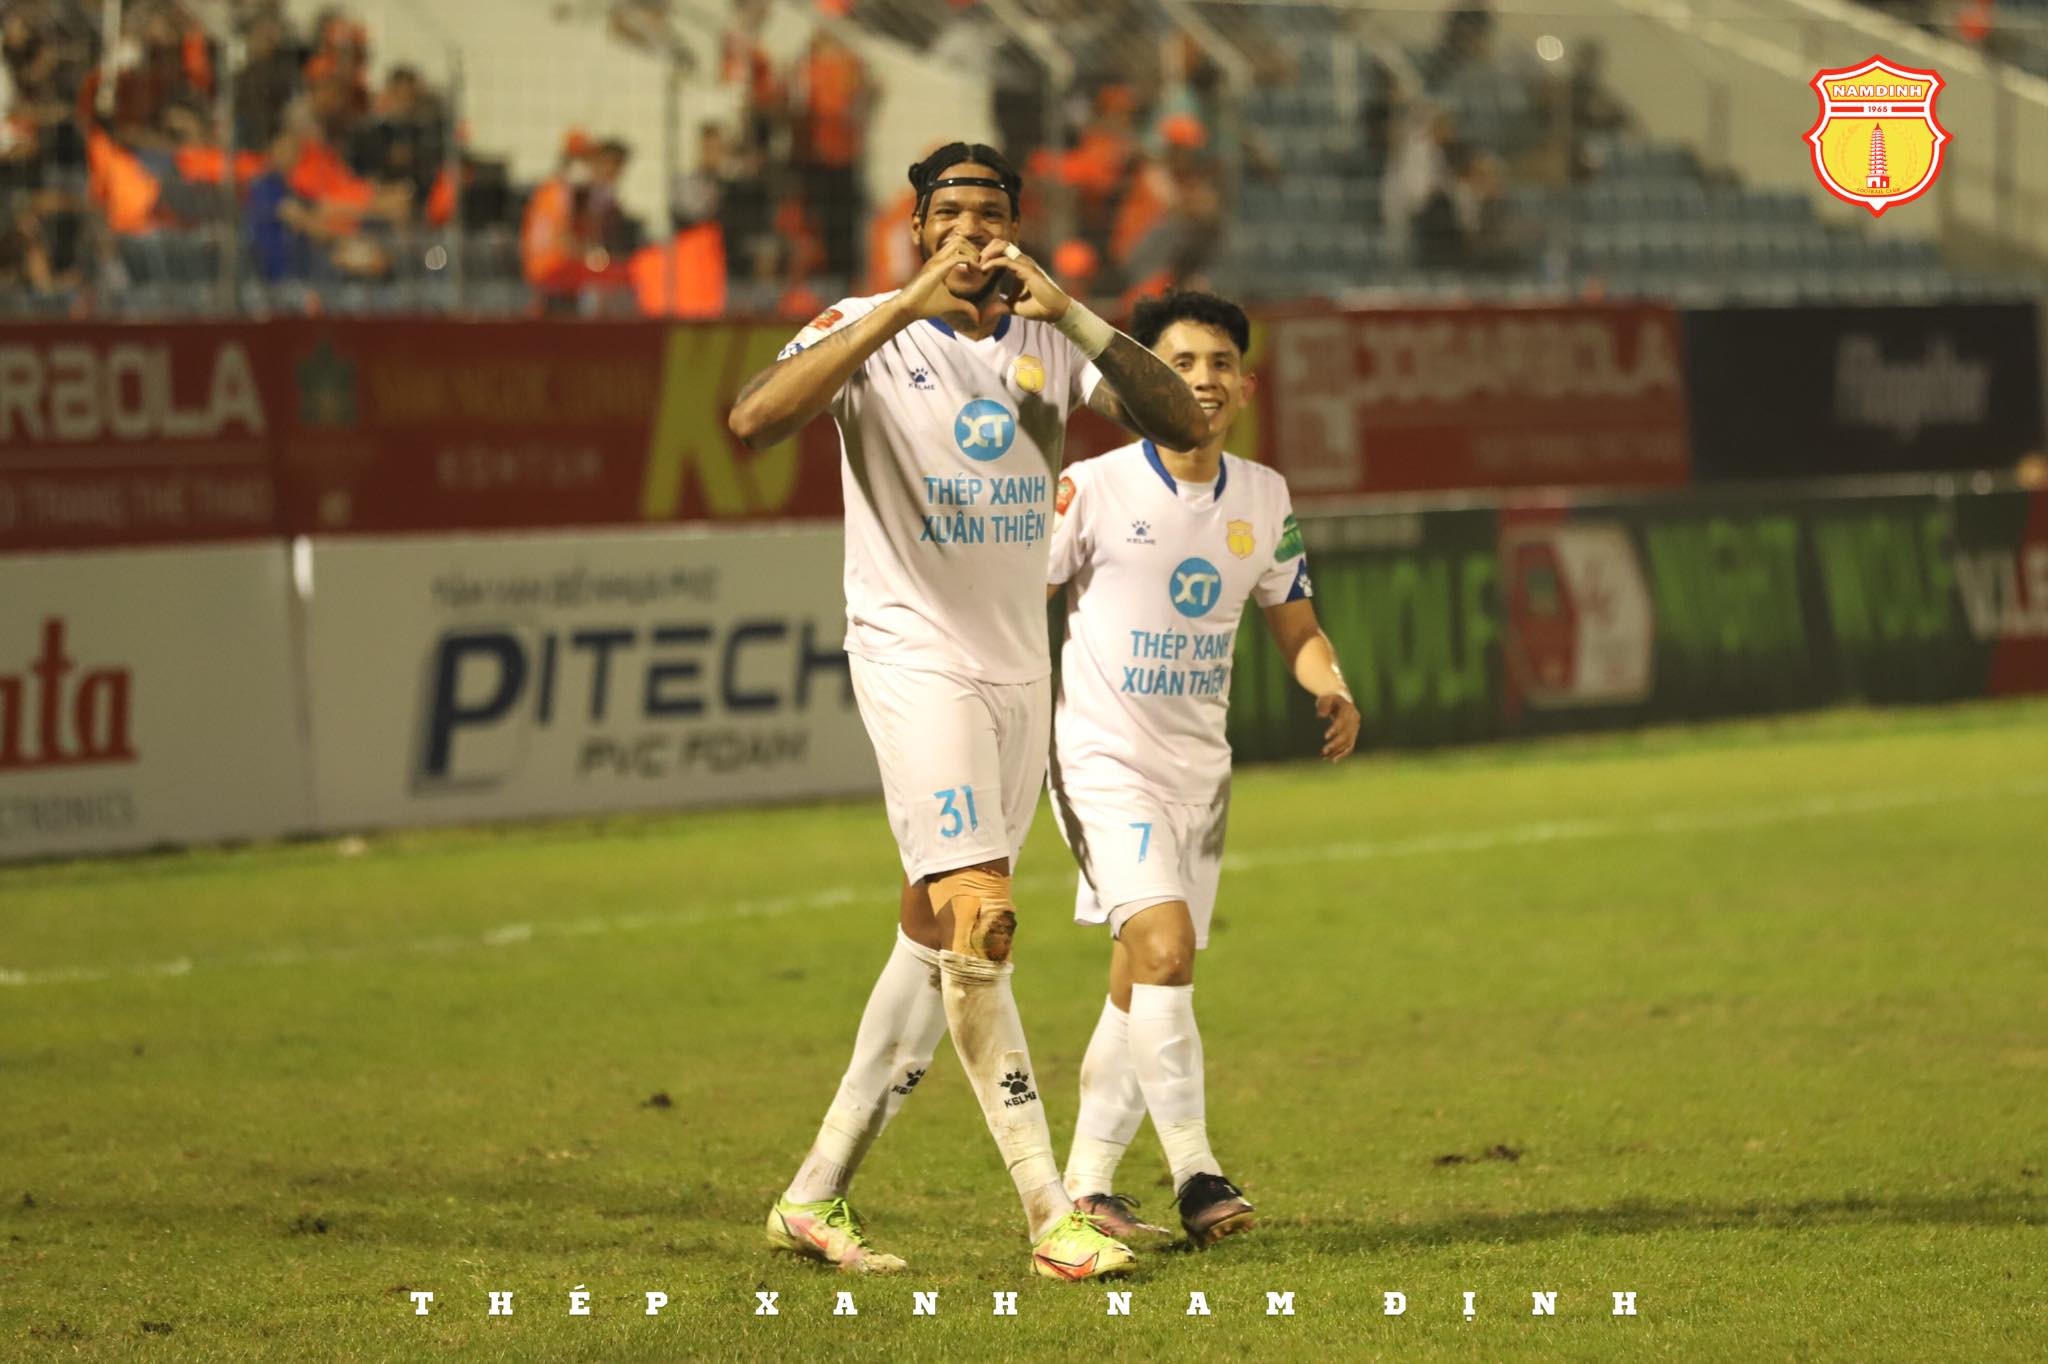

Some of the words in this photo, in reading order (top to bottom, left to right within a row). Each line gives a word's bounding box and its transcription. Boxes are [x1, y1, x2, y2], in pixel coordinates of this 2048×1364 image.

[961, 414, 1009, 448] XT
[924, 473, 983, 505] THÉP
[990, 476, 1046, 505] XANH
[920, 511, 985, 544] XUÂN
[992, 509, 1045, 547] THIỆN
[1175, 572, 1219, 607] XT
[1130, 628, 1187, 660] THÉP
[1121, 664, 1185, 696] XUÂN
[934, 785, 978, 838] 31
[1129, 822, 1152, 864] 7
